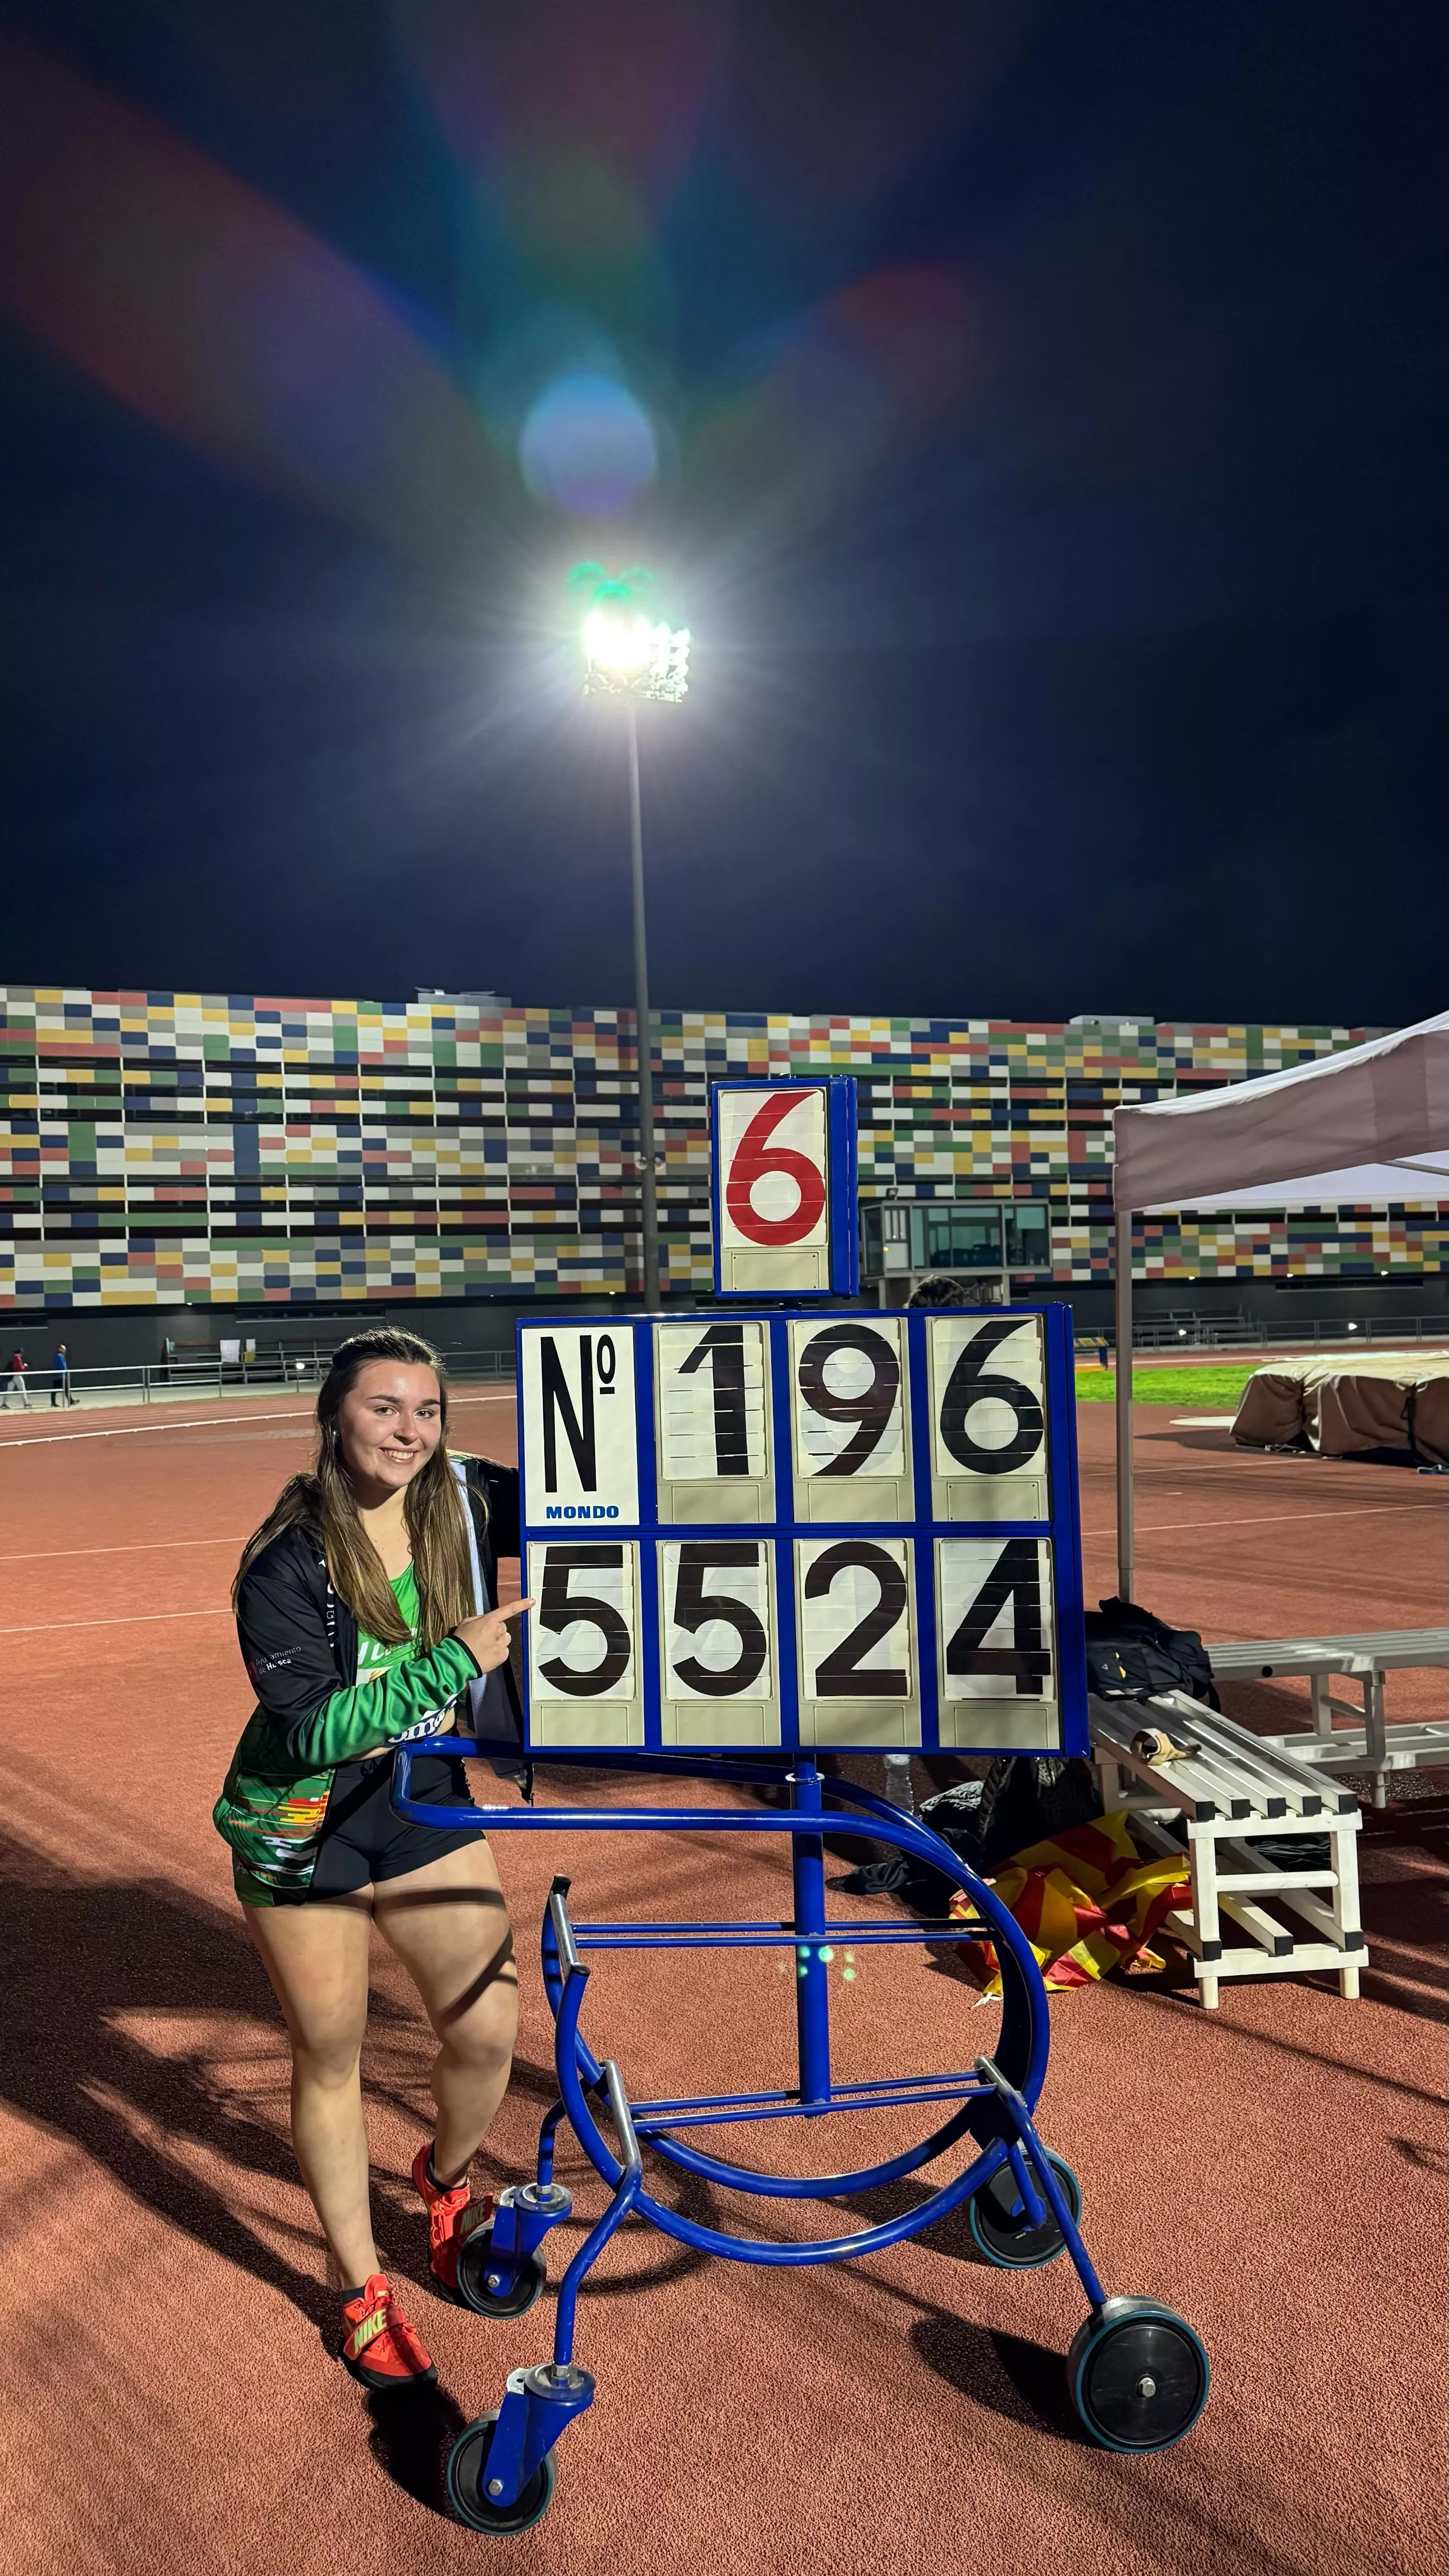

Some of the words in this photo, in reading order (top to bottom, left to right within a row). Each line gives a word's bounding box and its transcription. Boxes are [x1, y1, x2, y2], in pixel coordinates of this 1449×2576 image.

[726, 1091, 825, 1246] 6
[546, 1505, 619, 1518] MONDO
[538, 1539, 1051, 1697] 5524
[256, 1647, 301, 1666] Ayuamiento
[266, 1658, 291, 1670] Husca
[388, 1708, 446, 1743] oma
[459, 2200, 486, 2234] NIKE
[354, 2308, 387, 2355] NIKE
